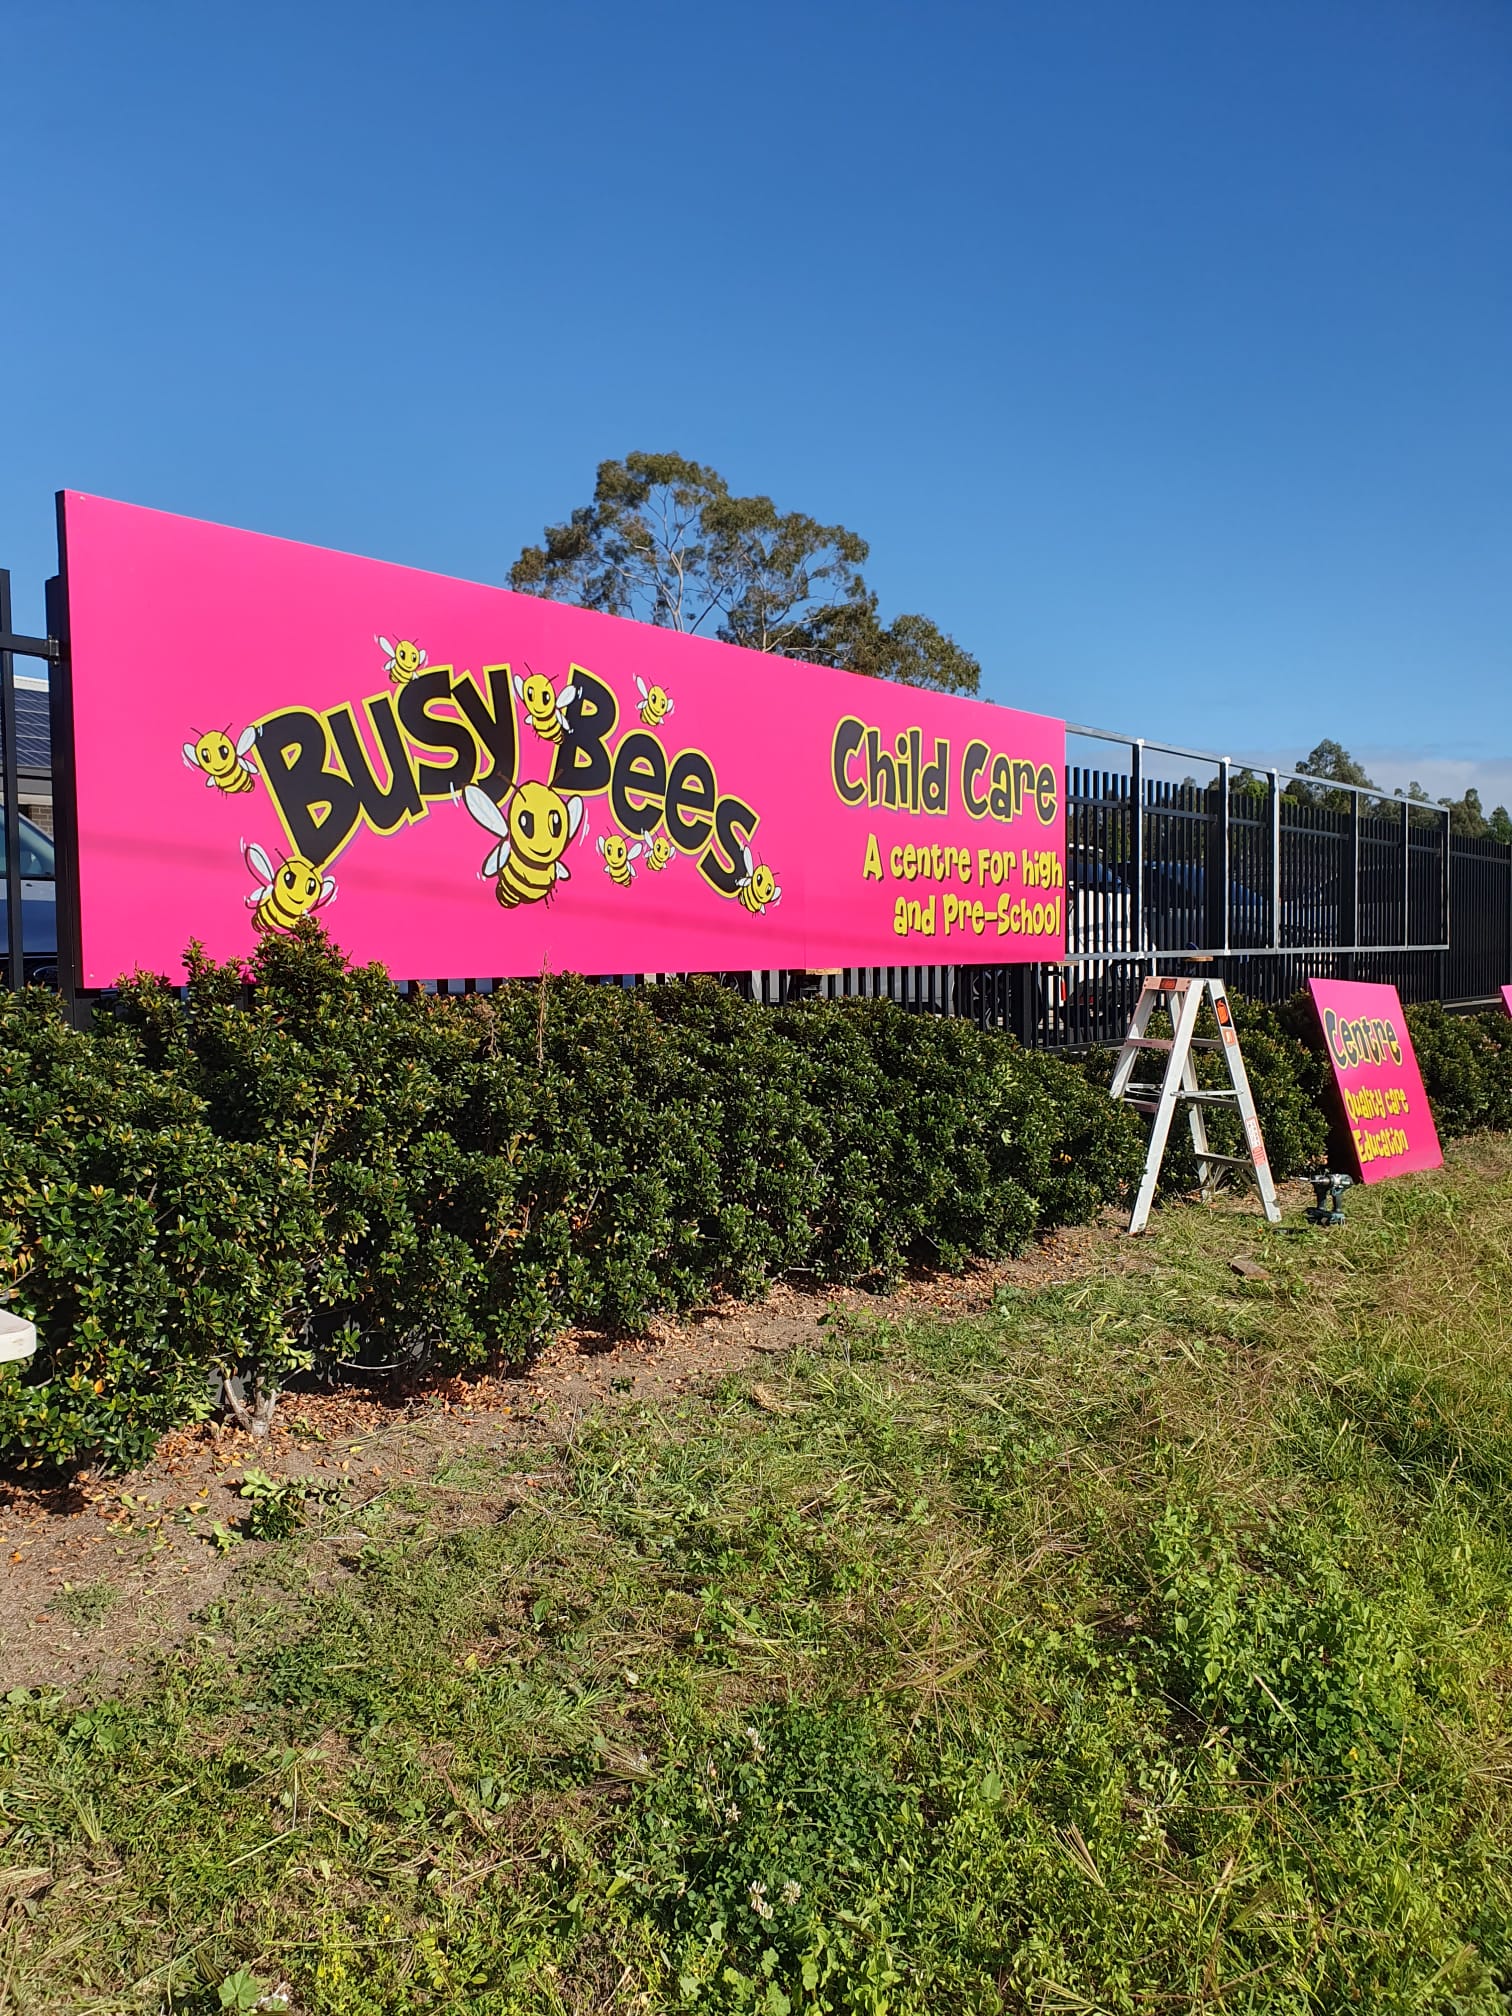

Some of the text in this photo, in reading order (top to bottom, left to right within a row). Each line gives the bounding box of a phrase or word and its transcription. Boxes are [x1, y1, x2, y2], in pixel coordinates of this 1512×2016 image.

[549, 663, 760, 899] Bees
[831, 715, 1059, 826] Child Care
[862, 832, 884, 881] A
[890, 844, 972, 884] centre
[1022, 849, 1063, 890] high
[893, 893, 1061, 937] and Pre-School
[1323, 1008, 1404, 1070] Centre
[1344, 1085, 1409, 1126] Quality care
[1352, 1127, 1409, 1164] Education
